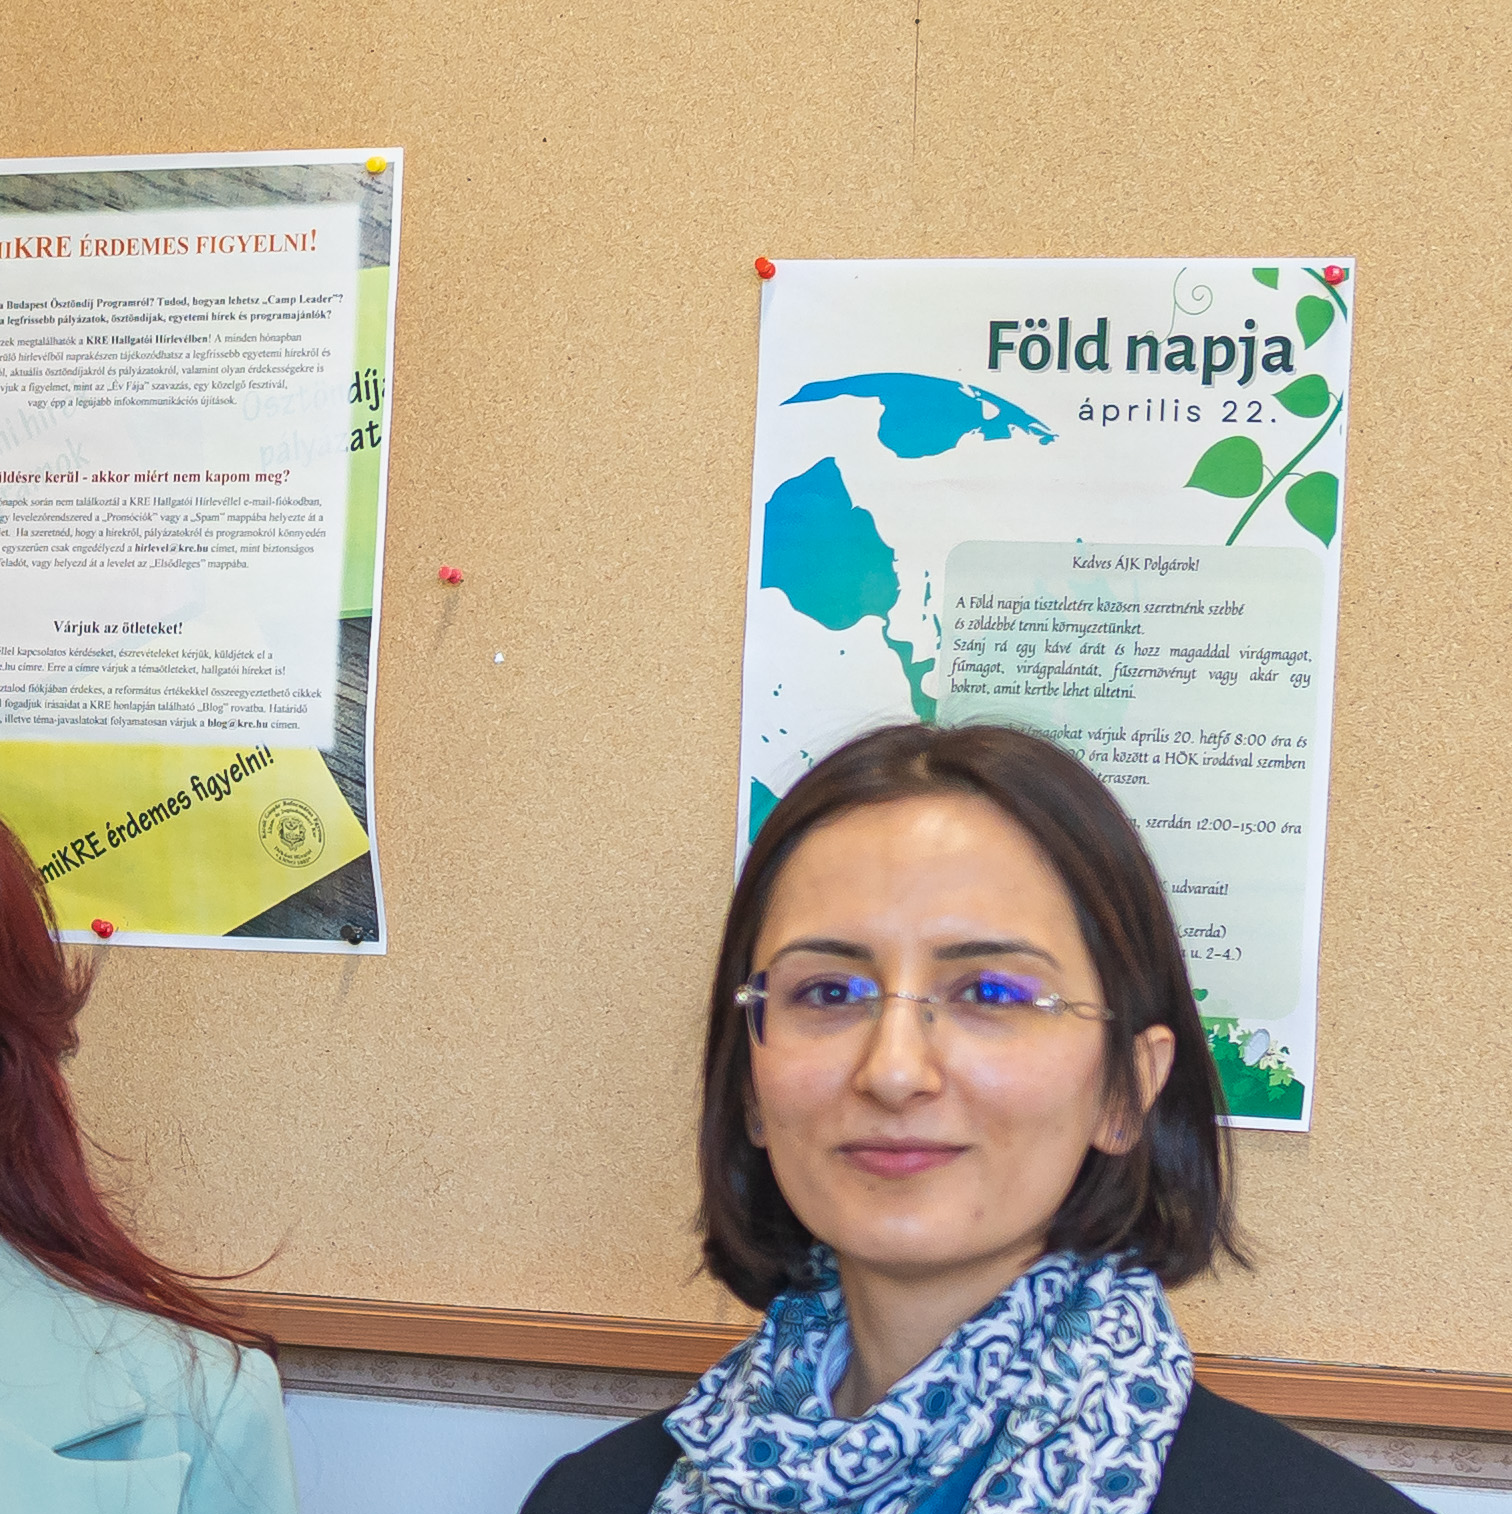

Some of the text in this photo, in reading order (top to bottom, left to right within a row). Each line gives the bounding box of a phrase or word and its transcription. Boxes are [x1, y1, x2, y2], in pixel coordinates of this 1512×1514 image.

[80, 234, 188, 257] ÉRDEMES
[196, 229, 316, 253] FIGYELNI!
[6, 300, 47, 311] Budapest
[50, 297, 93, 310] Ösztöndíj
[96, 297, 154, 308] Programról?
[156, 296, 190, 307] Tudod,
[192, 296, 225, 307] hogyan
[228, 295, 259, 304] lehetsz
[7, 315, 55, 326] legfrissebb
[57, 314, 109, 326] pályázatok,
[110, 312, 166, 324] ösztöndíjak,
[168, 312, 208, 324] egyetemi
[211, 311, 235, 320] hírek
[238, 311, 247, 320] és
[250, 309, 332, 322] programajánlók?
[17, 336, 76, 348] megtalálhatók
[86, 335, 108, 345] KRE
[111, 334, 152, 346] Hallgatói
[155, 334, 211, 343] Hírlevélben!
[214, 333, 221, 343] A
[224, 333, 257, 342] minden
[259, 332, 301, 343] hónapban
[987, 317, 1294, 387] Föld napja
[1078, 398, 1277, 426] április 22.
[44, 470, 78, 483] kerül
[91, 470, 130, 482] akkor
[134, 469, 168, 482] miért
[173, 473, 200, 482] nem
[205, 469, 250, 485] kapom
[255, 469, 290, 485] meg?
[1072, 554, 1200, 576] Kedves ÁJK Polgárok!
[955, 594, 1245, 615] A Föld napja tiszteletére közösen szeretnénk szebbé
[53, 620, 182, 636] Várjuk az ötleteket!
[954, 617, 964, 629] és
[967, 616, 1016, 631] zöldebbé
[1018, 617, 1048, 631] tenni
[952, 637, 985, 656] Szánj
[994, 639, 1008, 652] rá
[1015, 643, 1036, 658] egy
[1044, 638, 1072, 654] kávé
[1079, 642, 1105, 655] árát
[1114, 643, 1125, 655] és
[1133, 641, 1160, 656] hozz
[1169, 643, 1230, 663] magaddal
[1208, 670, 1238, 686] vagy
[1249, 666, 1279, 681] akár
[1289, 673, 1311, 688] egy
[993, 680, 1020, 694] amit
[1024, 680, 1059, 696] kertbe
[1062, 681, 1089, 697] lehet
[1093, 682, 1136, 698] ültetni.
[1087, 726, 1126, 745] várjuk
[1130, 728, 1169, 746] április
[1173, 730, 1194, 744] 20.
[1199, 729, 1232, 750] hétfő
[1233, 733, 1266, 746] 8:00
[1270, 734, 1291, 747] óra
[1296, 735, 1307, 748] és
[1088, 749, 1108, 762] óra
[1112, 748, 1148, 763] között
[1152, 754, 1160, 764] a
[1202, 751, 1253, 767] irodával
[1256, 753, 1305, 769] szemben
[106, 790, 192, 849] érdemes
[190, 742, 274, 802] figyelni!
[1145, 814, 1191, 829] szerdán
[1280, 821, 1301, 834] óra
[1172, 880, 1229, 895] udvarait!
